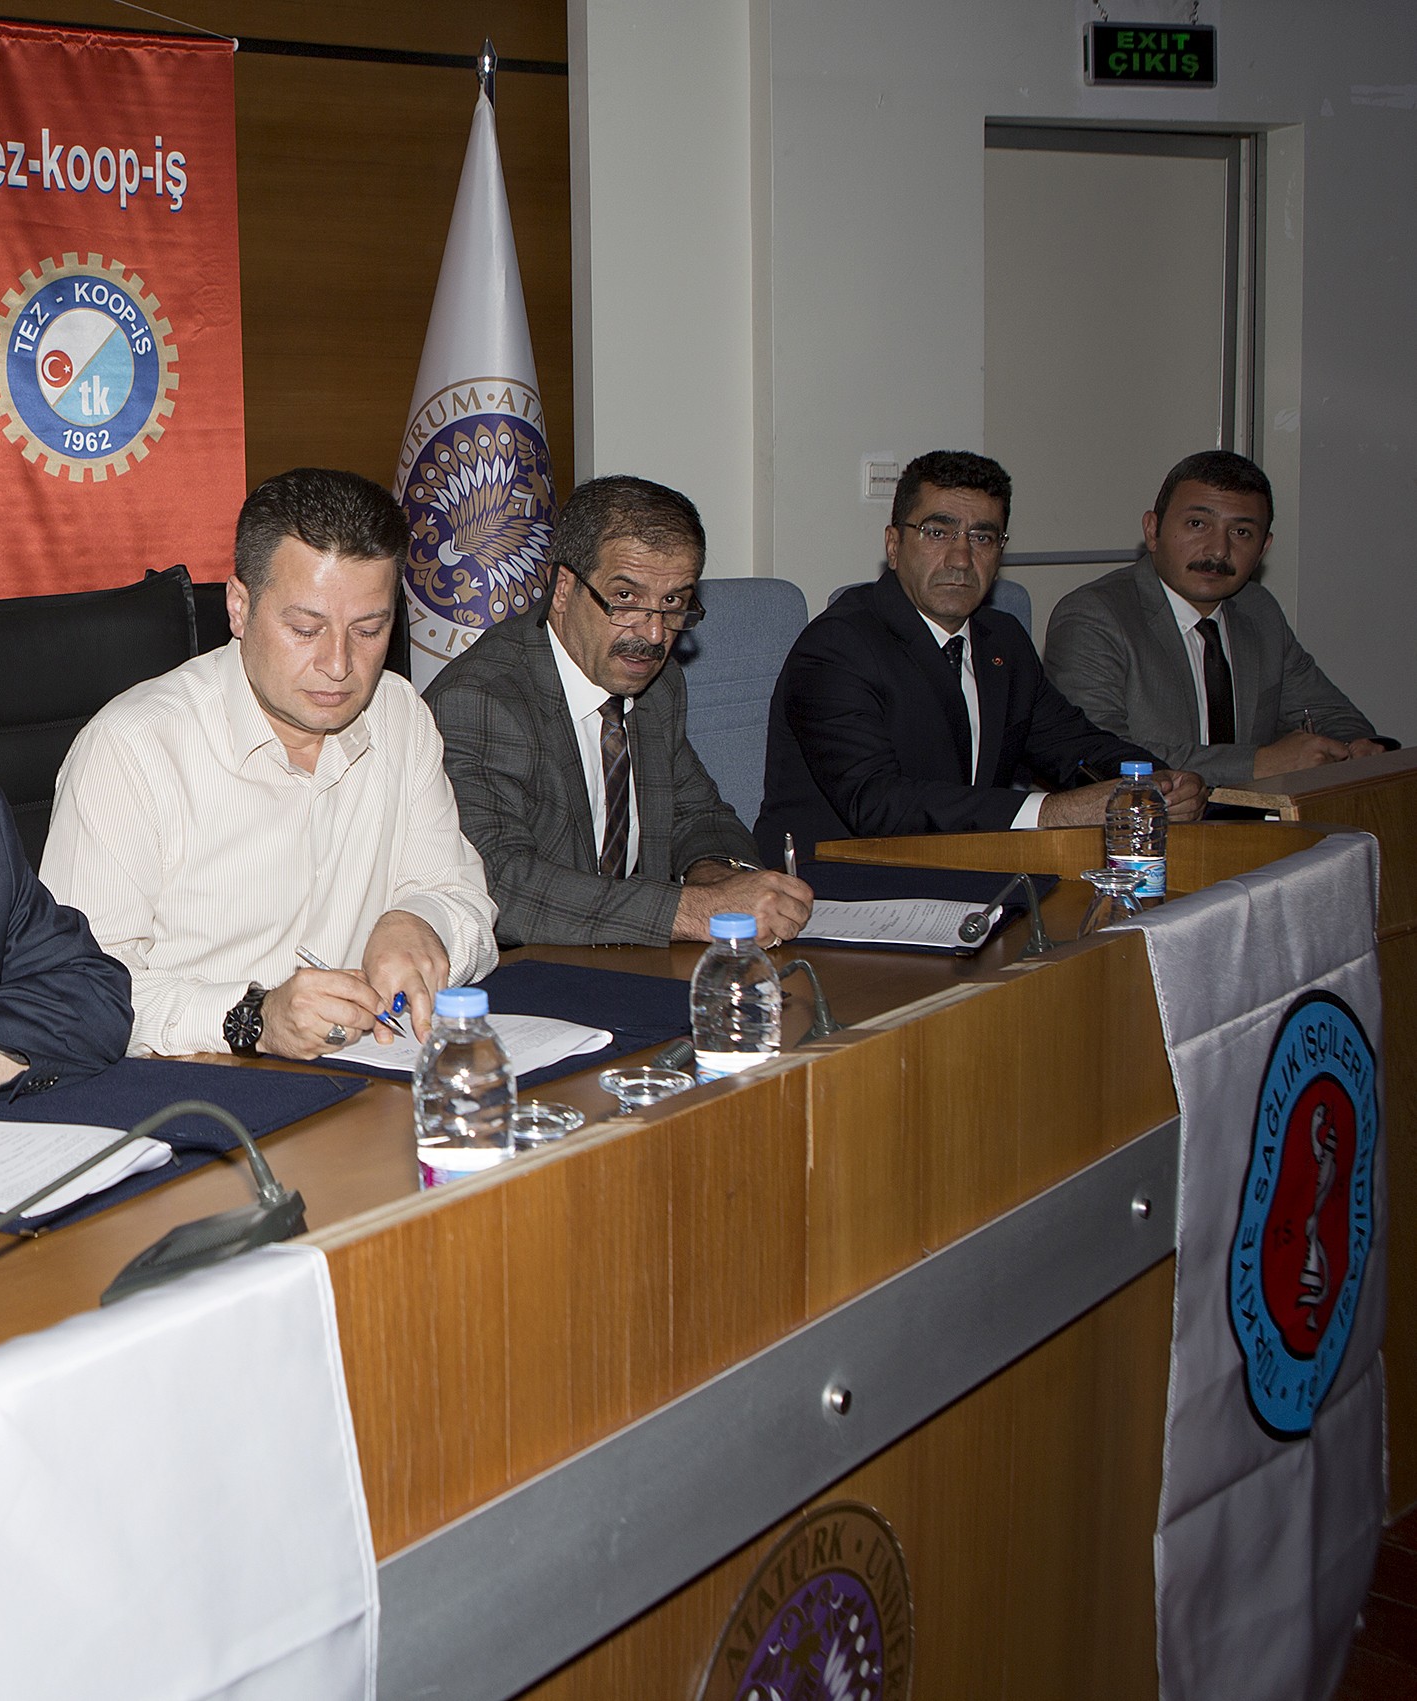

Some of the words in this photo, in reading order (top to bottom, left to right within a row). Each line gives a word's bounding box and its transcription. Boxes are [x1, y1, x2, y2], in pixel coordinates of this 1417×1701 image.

[1108, 51, 1200, 78] ÇIKIŞ
[14, 301, 50, 353] TEZ
[74, 282, 152, 355] KOOP-İŞ
[79, 375, 111, 416] tk
[62, 429, 112, 452] 1962
[394, 387, 482, 503] ZURUM
